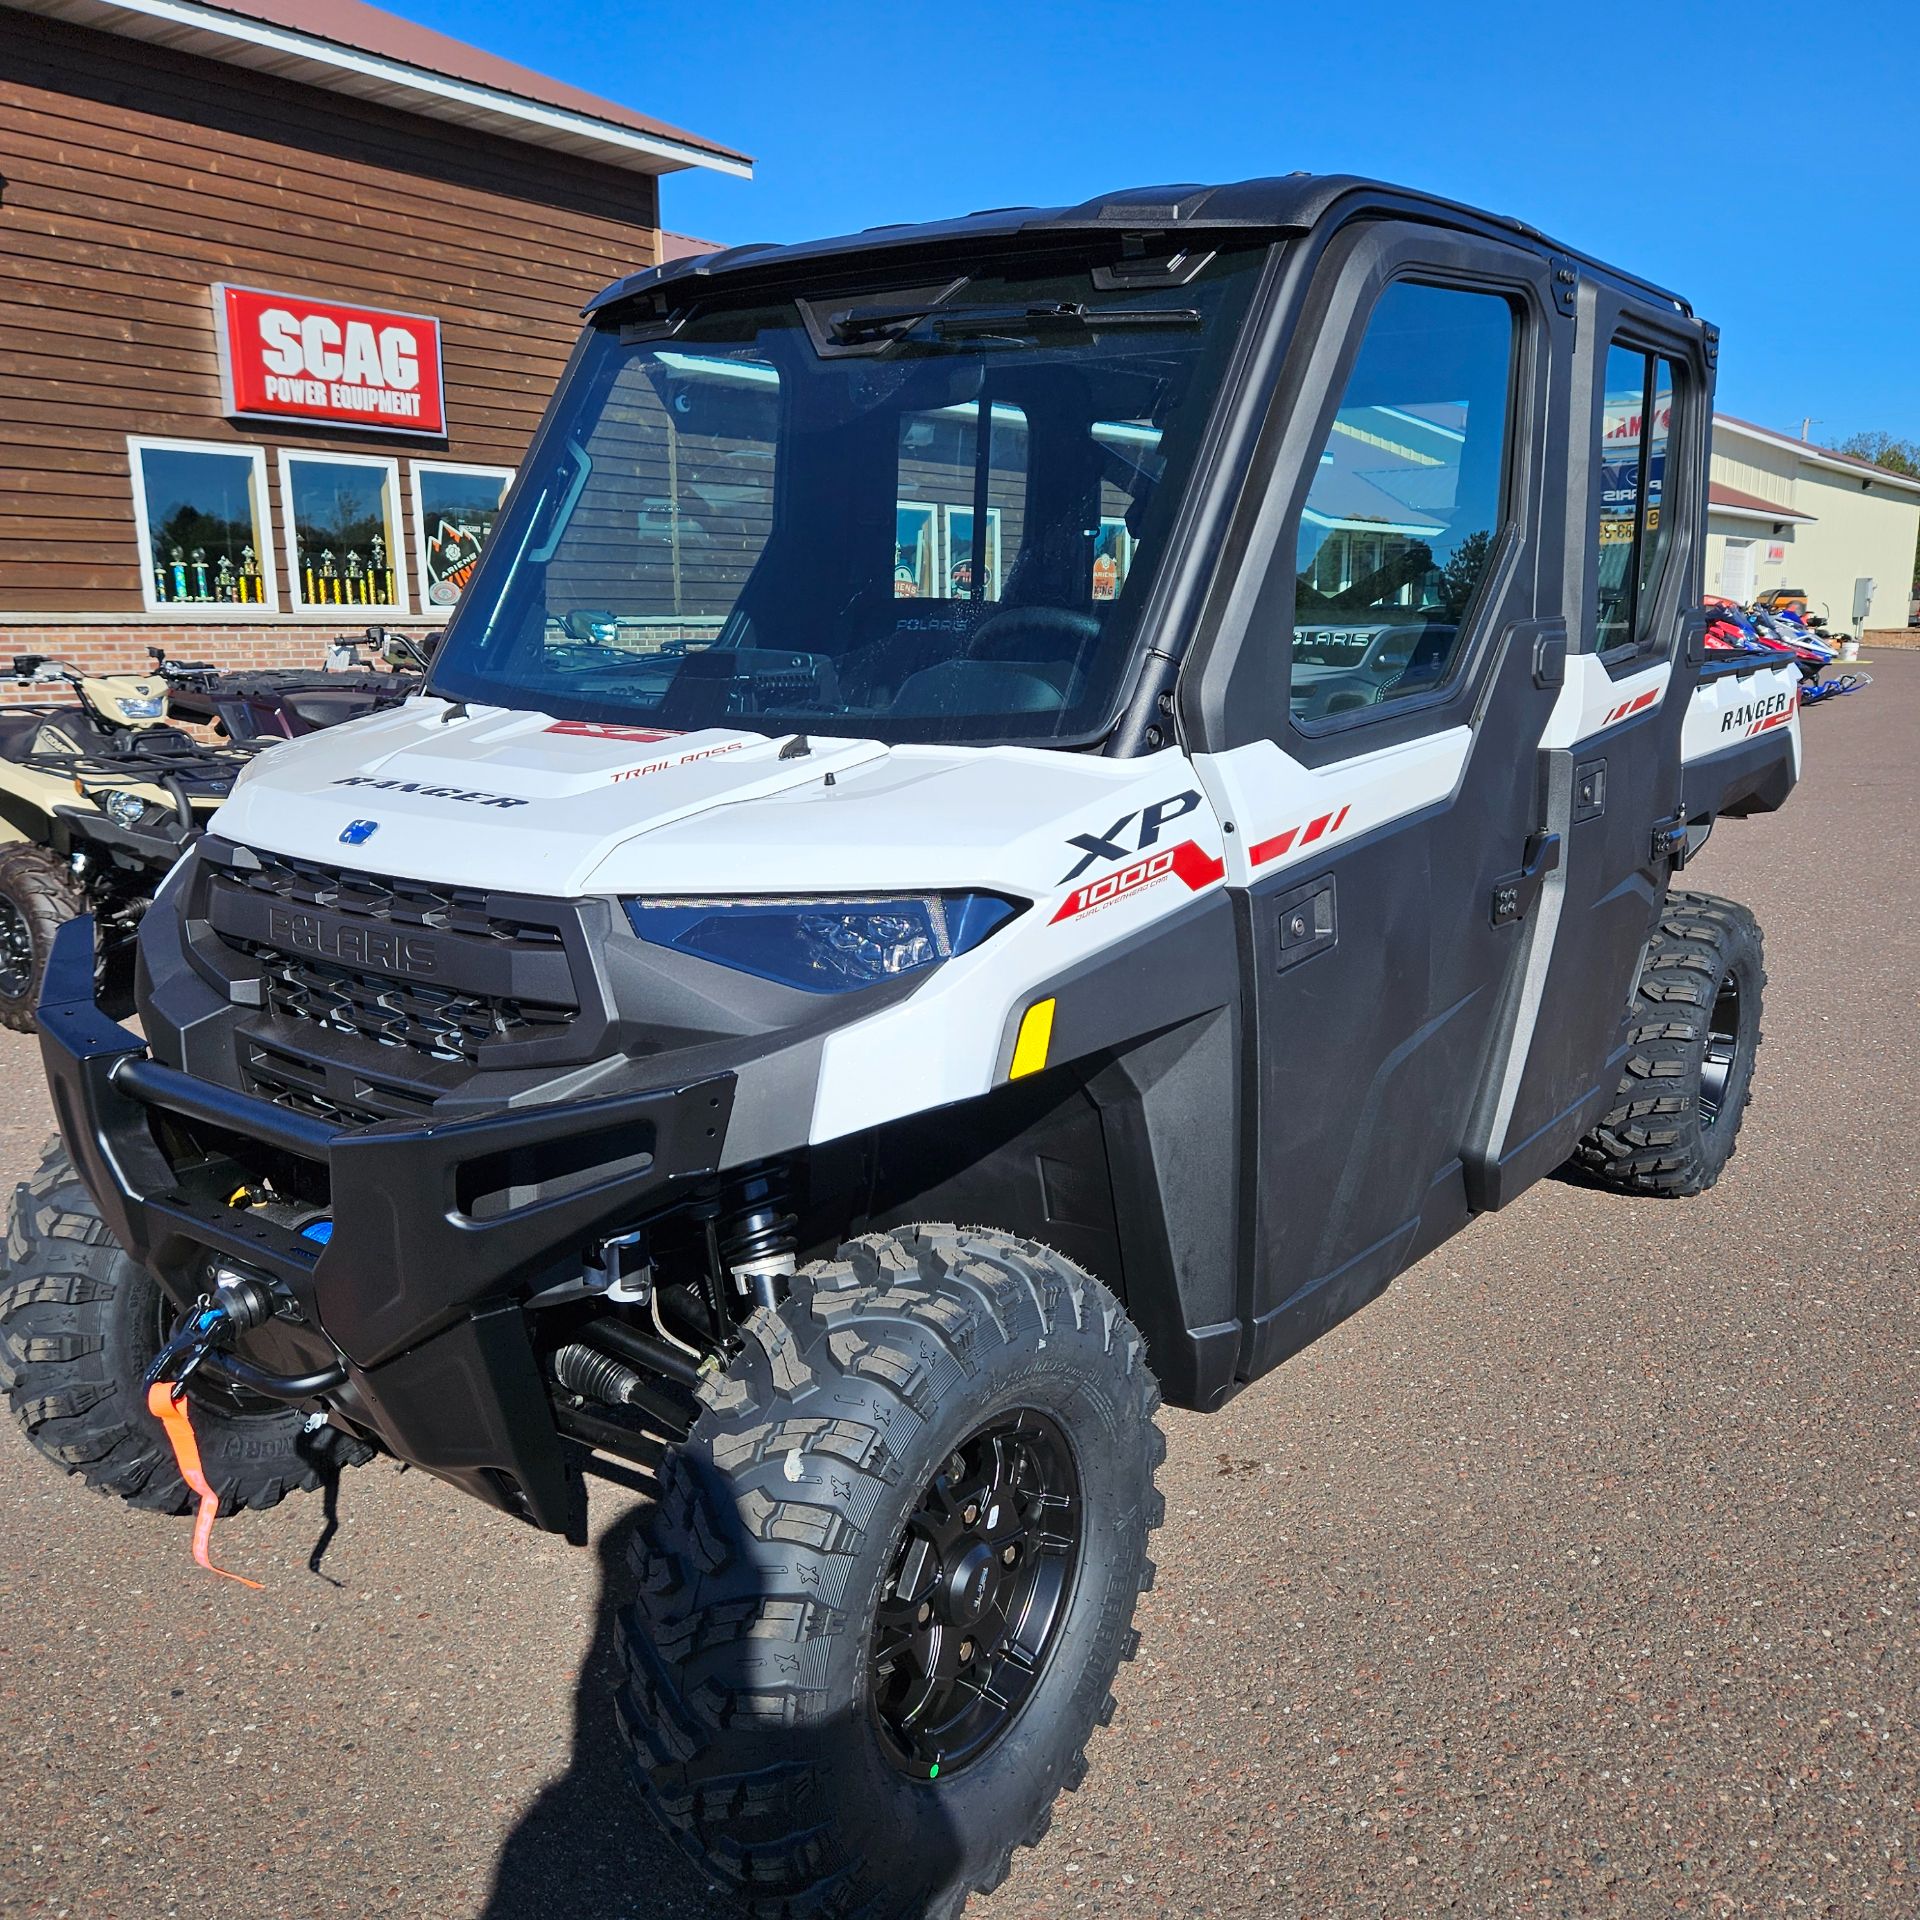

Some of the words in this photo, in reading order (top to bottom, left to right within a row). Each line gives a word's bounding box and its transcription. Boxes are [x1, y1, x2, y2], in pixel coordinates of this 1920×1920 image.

[259, 308, 419, 390] SCAG
[264, 375, 327, 406] POWER
[330, 383, 421, 417] EQUIPMENT
[441, 552, 477, 579] ARIENS
[896, 619, 967, 631] POLARIS
[1292, 631, 1369, 647] OLARIS
[1721, 692, 1786, 733] RANGER
[611, 761, 676, 782] TRAIL
[680, 742, 742, 764] BOSS
[328, 777, 529, 808] RANGER
[1054, 789, 1202, 887] XP
[1075, 907, 1100, 922] DUAL
[1102, 884, 1149, 910] OVERHEAD
[1150, 875, 1169, 888] CAM
[1077, 850, 1174, 910] 1000
[269, 907, 438, 977] POLARIS
